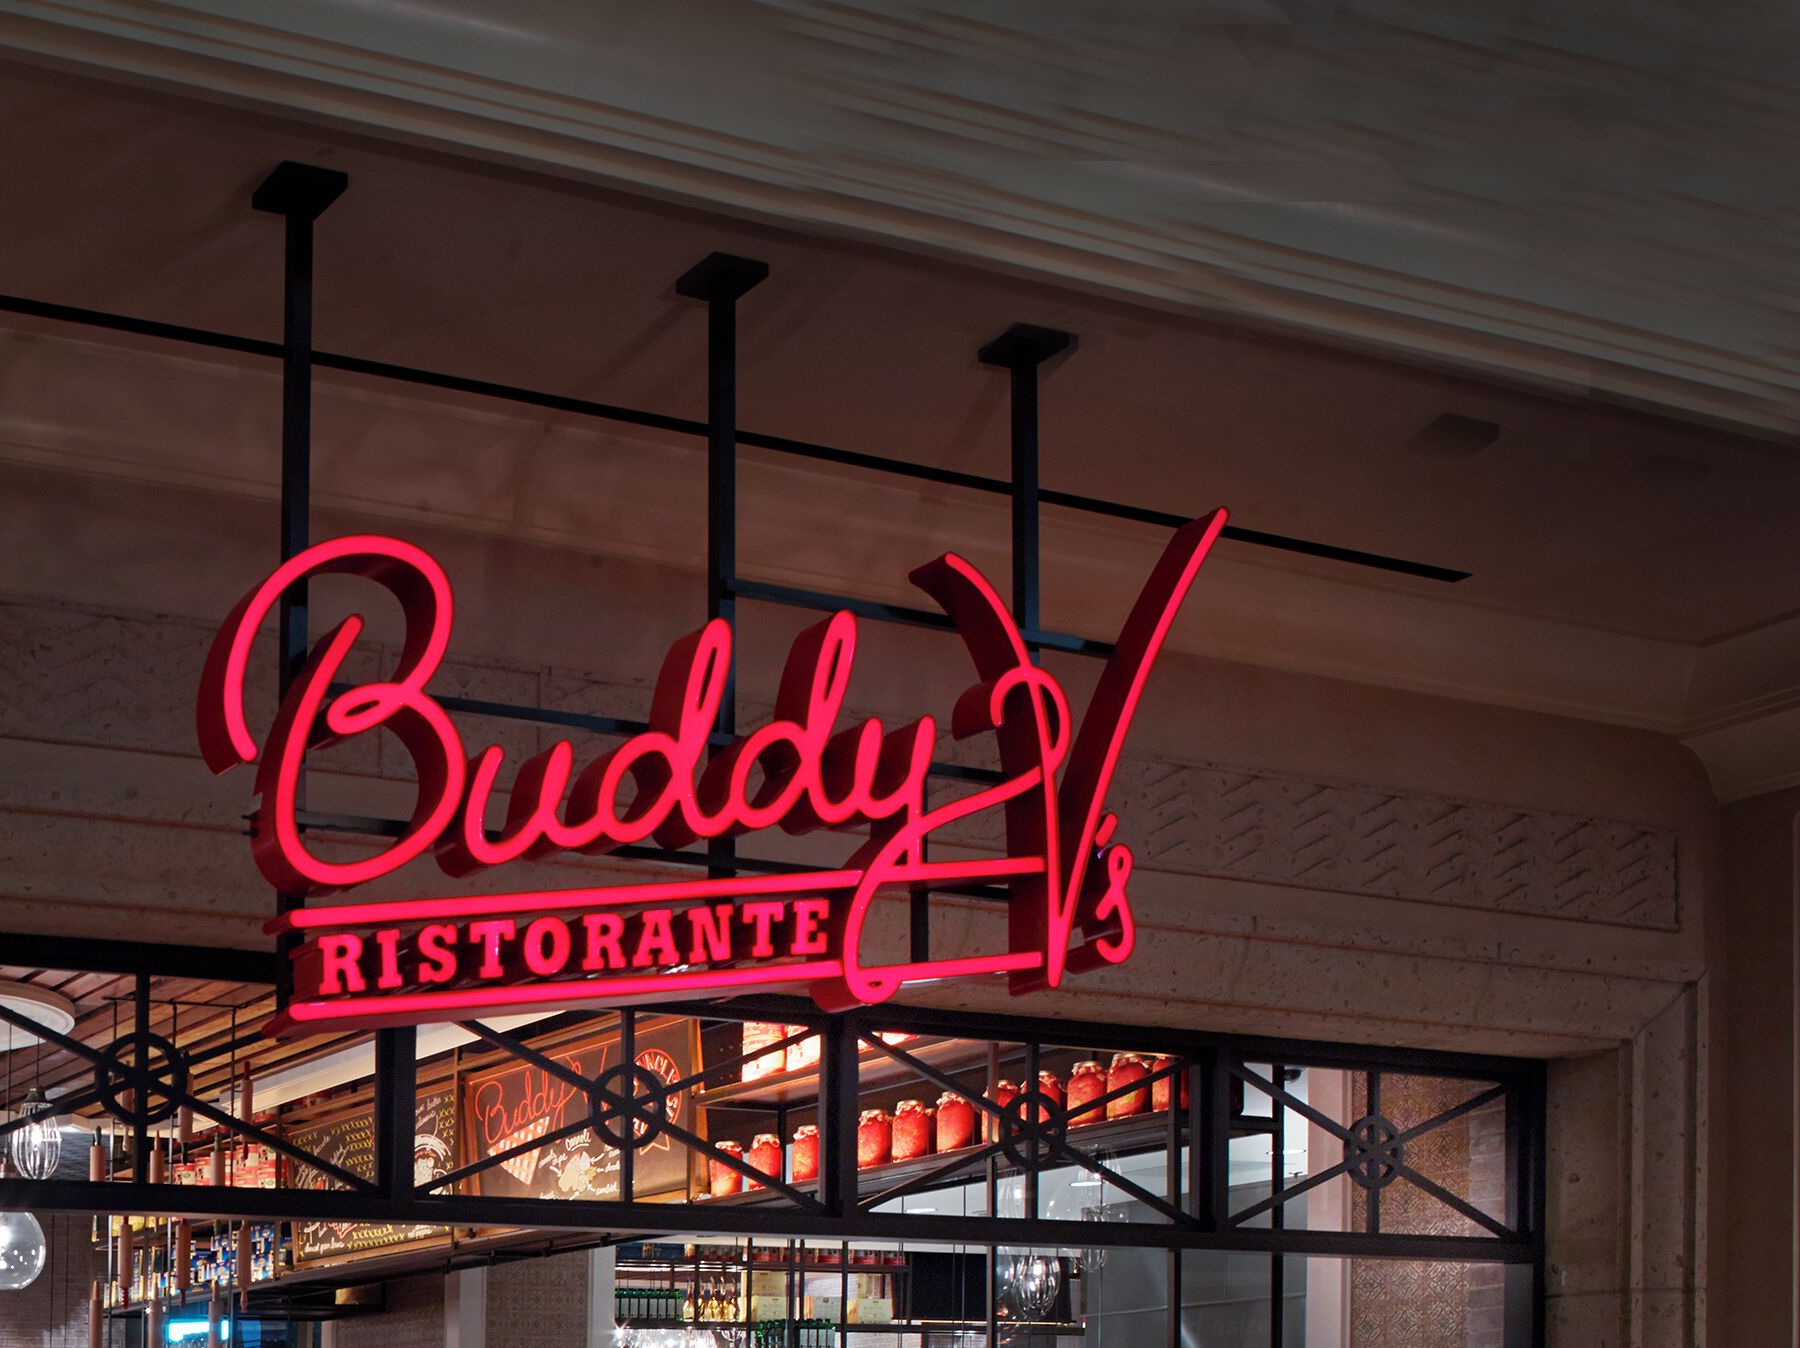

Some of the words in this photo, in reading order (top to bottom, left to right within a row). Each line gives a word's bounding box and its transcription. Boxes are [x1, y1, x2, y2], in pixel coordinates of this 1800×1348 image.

[210, 535, 955, 1000] Buddy
[922, 506, 1230, 990] V's
[317, 898, 831, 996] RISTORANTE
[474, 1066, 571, 1143] Buddy
